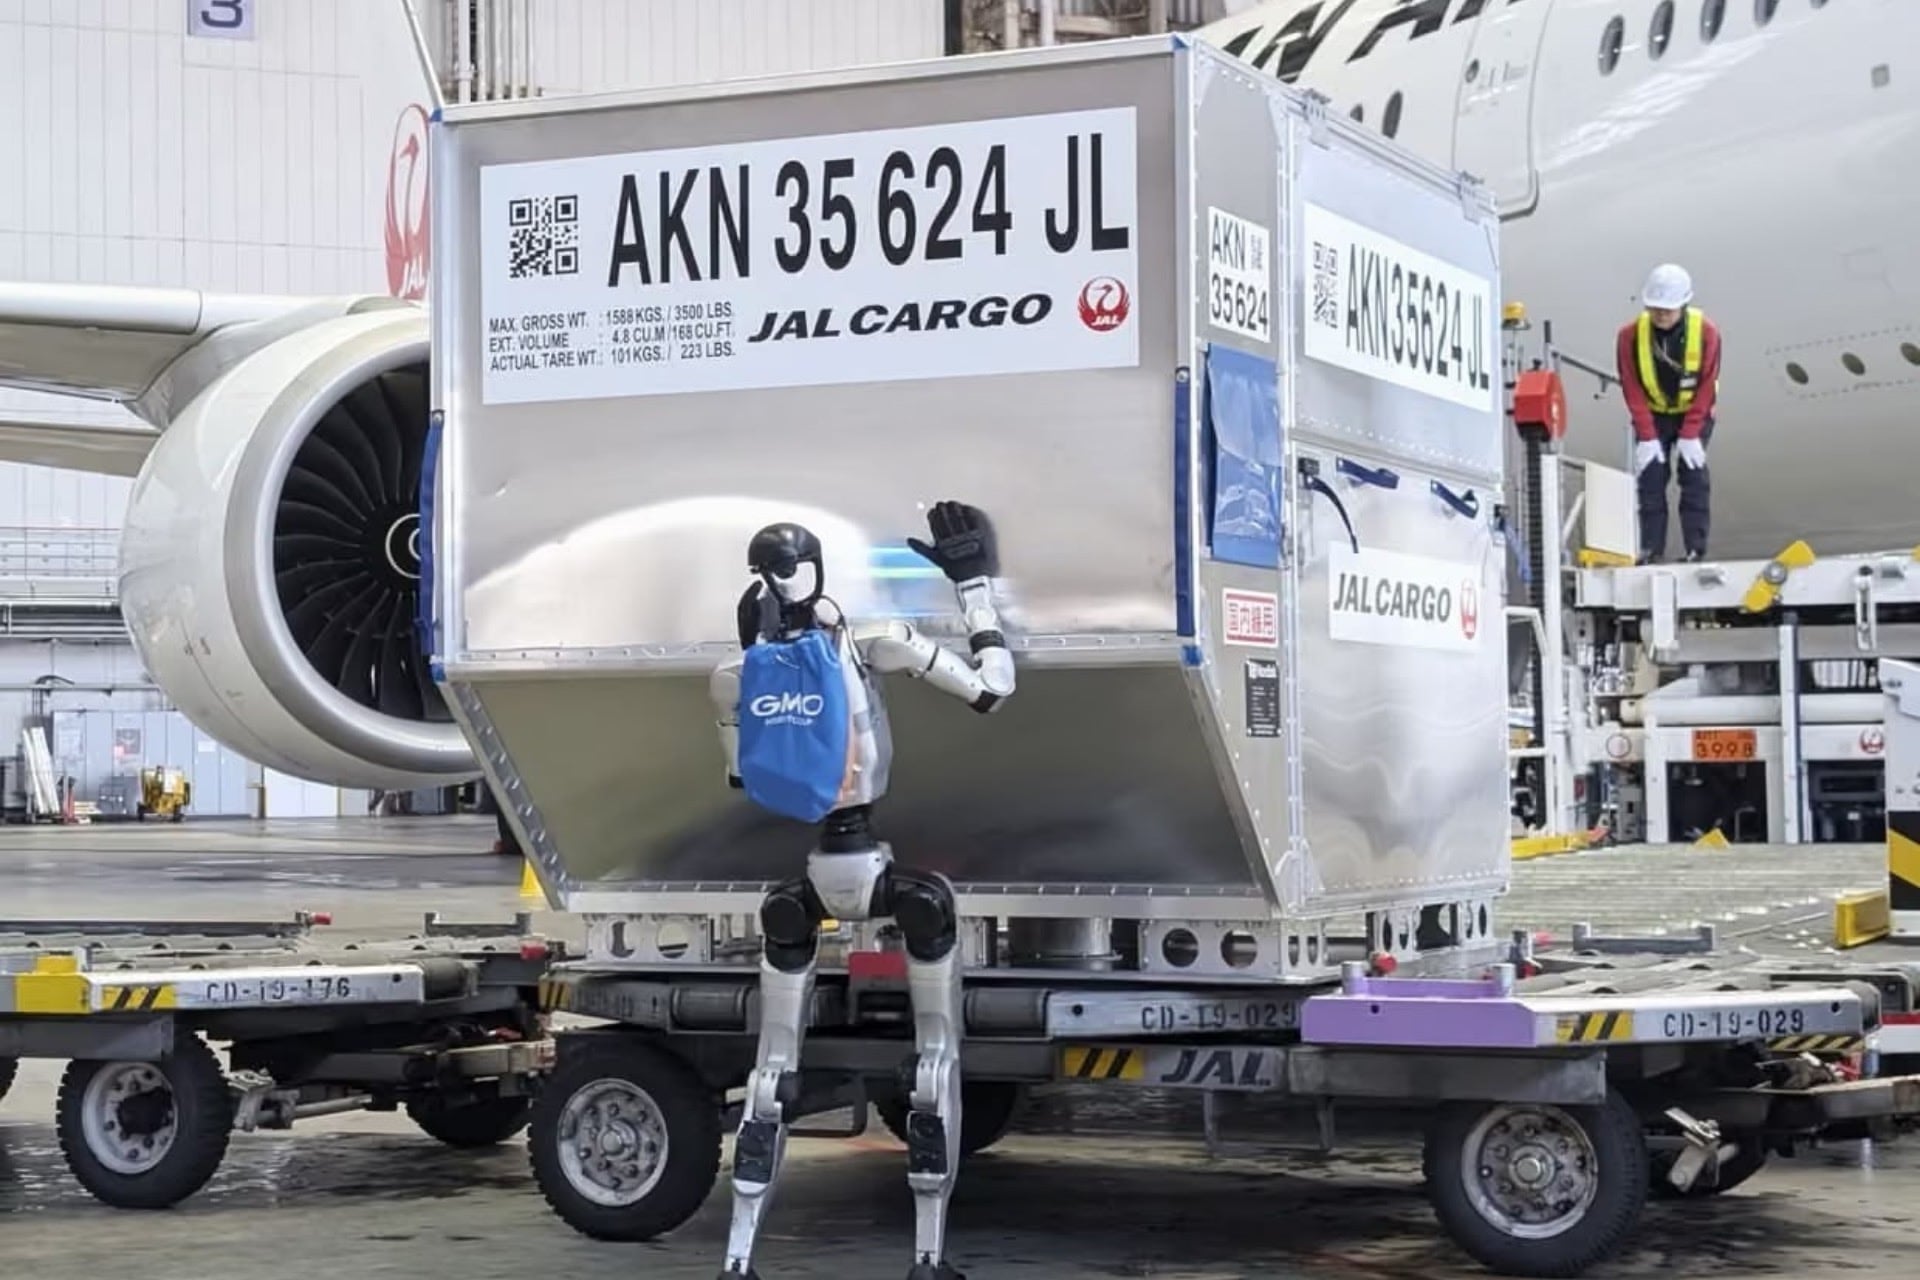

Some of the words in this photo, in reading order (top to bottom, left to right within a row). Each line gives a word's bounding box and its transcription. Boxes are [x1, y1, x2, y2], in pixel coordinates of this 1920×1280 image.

[607, 163, 750, 288] AKN
[1045, 132, 1129, 254] JL
[1211, 213, 1246, 271] AKN
[521, 313, 565, 332] GROSS
[674, 303, 703, 321] 3500
[748, 308, 840, 343] JAL
[850, 293, 1053, 336] CARGO
[1211, 272, 1268, 336] 35624
[1091, 314, 1119, 327] JAL
[518, 332, 570, 351] VOLUME
[490, 354, 540, 371] ACTUAL
[541, 350, 576, 368] TARE
[680, 342, 703, 360] 223
[750, 691, 824, 717] GMO
[207, 977, 350, 1003] CD-19-176
[1664, 1009, 1804, 1038] CD-19-029
[1160, 1049, 1271, 1087] JAL
